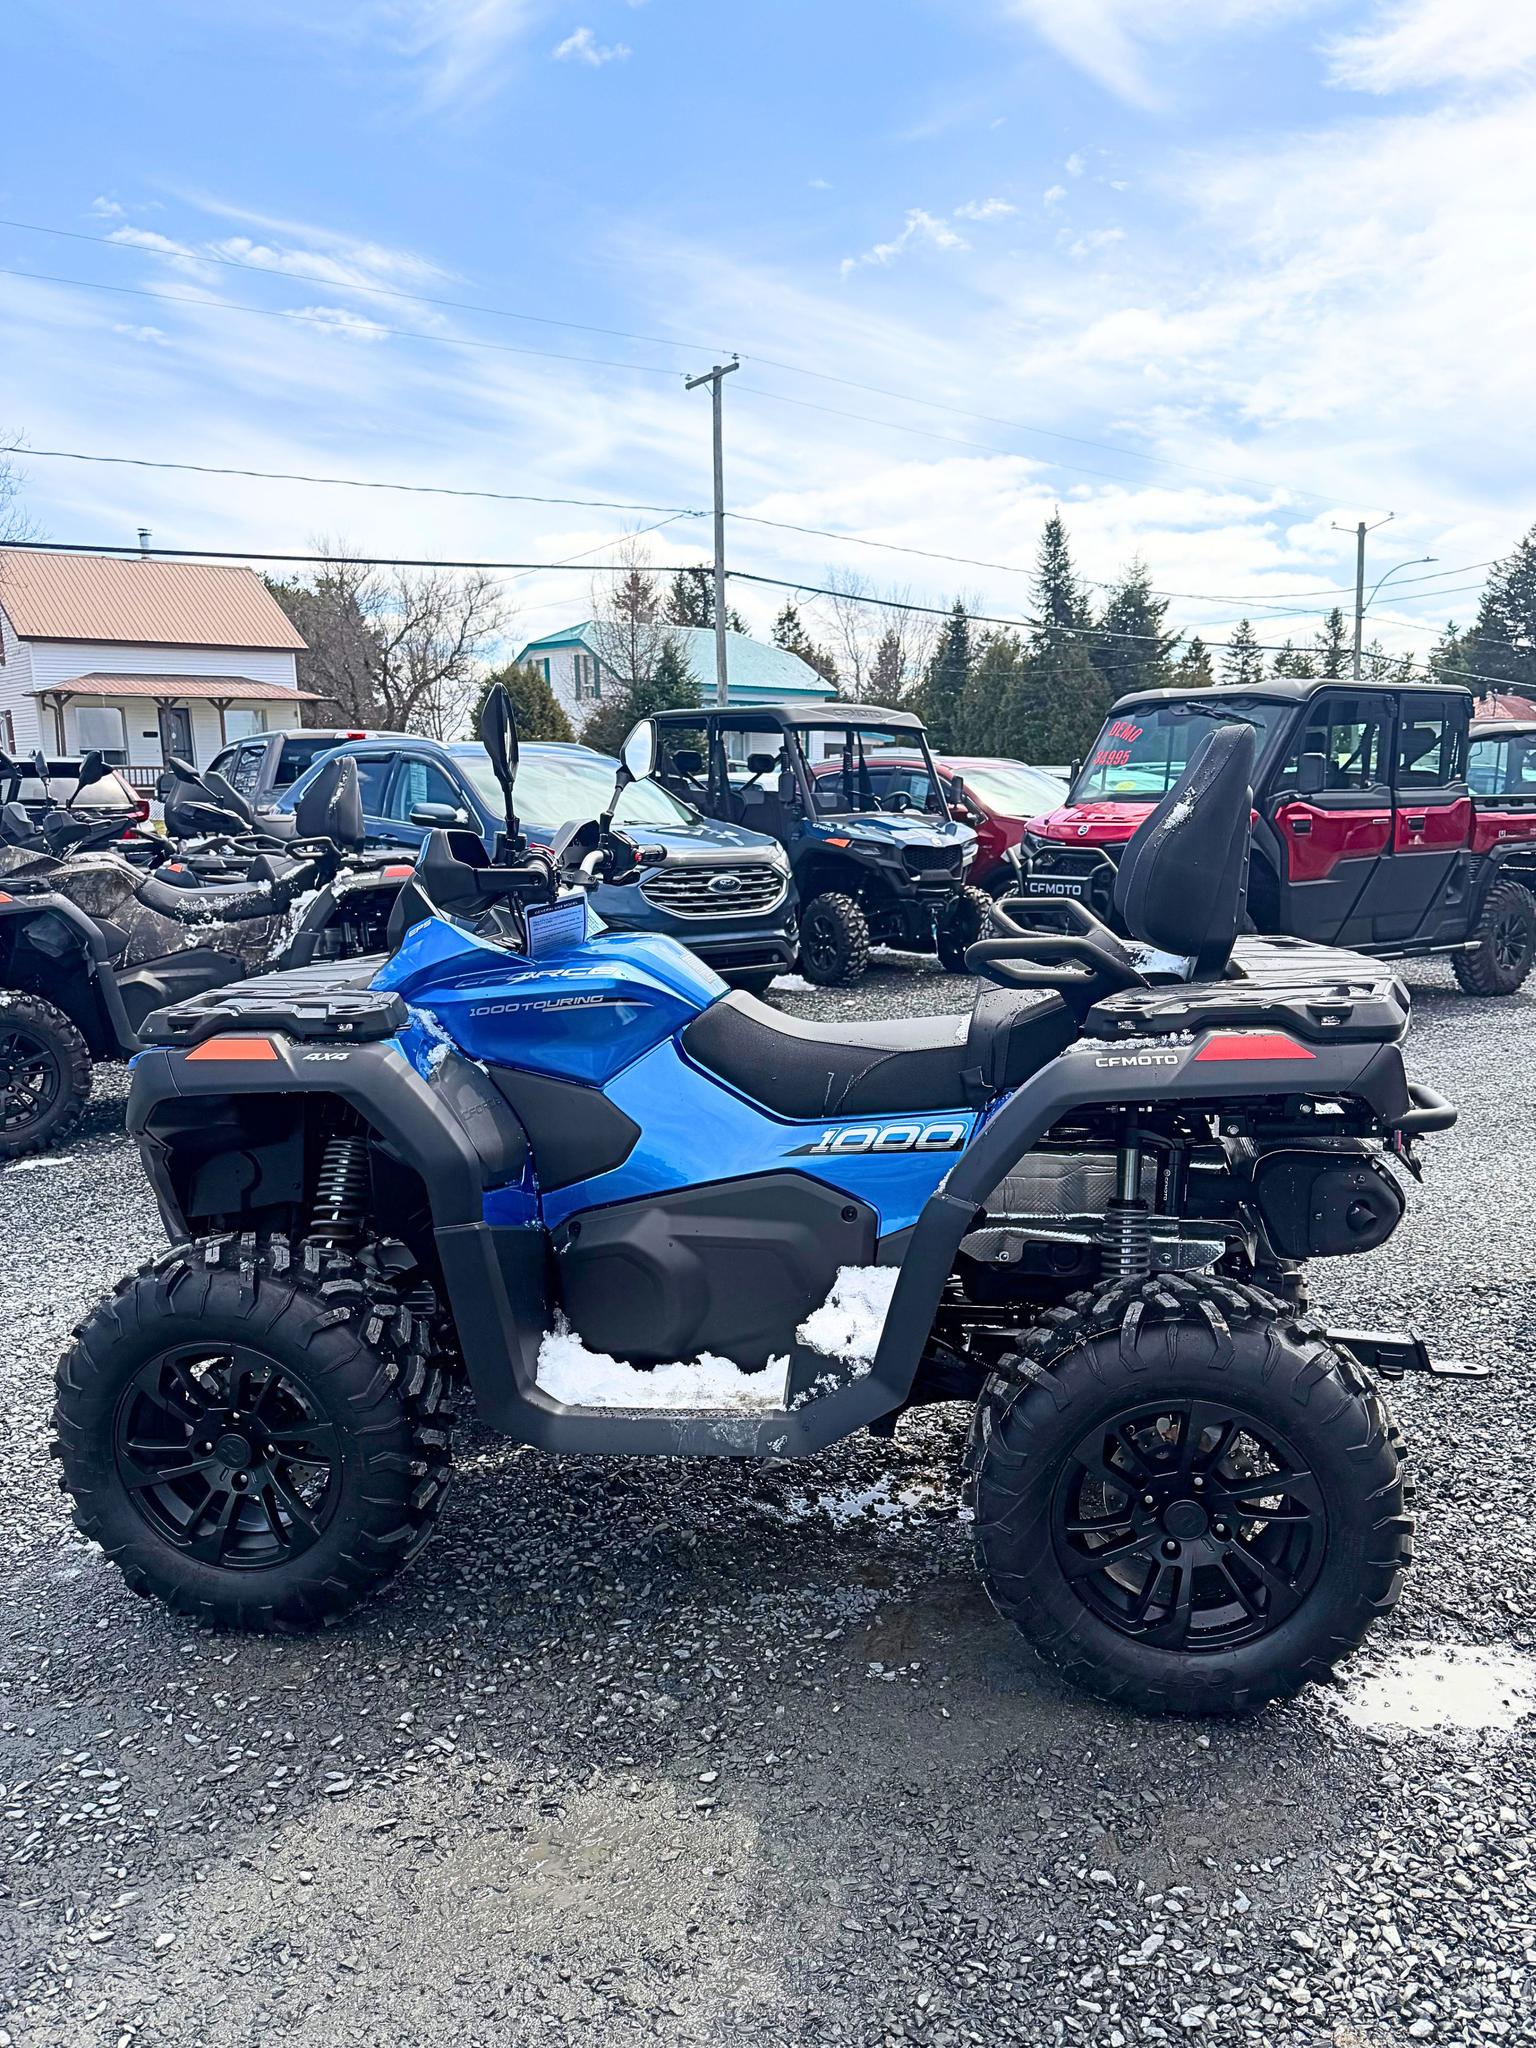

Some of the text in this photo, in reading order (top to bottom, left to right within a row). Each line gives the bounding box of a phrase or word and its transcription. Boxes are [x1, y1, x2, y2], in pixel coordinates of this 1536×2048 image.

[1108, 720, 1143, 743] DEMO
[1029, 882, 1082, 896] CFMOTO
[408, 919, 431, 937] EPS
[469, 995, 604, 1017] 1000 TOURING
[1095, 1055, 1179, 1068] CFMOTO
[809, 1121, 969, 1153] 1000
